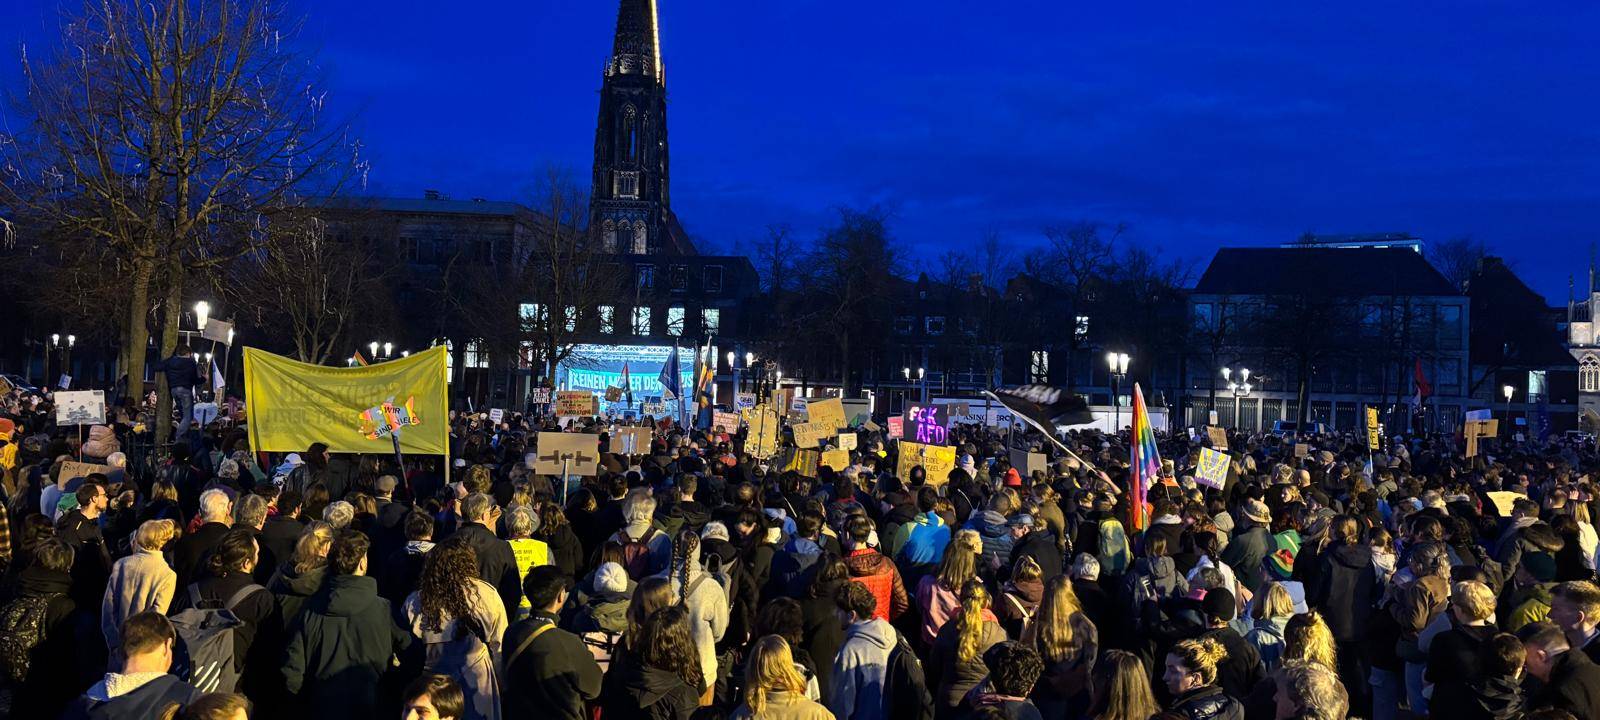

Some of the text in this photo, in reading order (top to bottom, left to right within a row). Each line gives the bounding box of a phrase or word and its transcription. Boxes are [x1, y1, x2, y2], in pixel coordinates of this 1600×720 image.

[573, 372, 606, 390] KEINEN
[384, 406, 401, 414] WIR
[909, 406, 938, 425] FCK
[374, 416, 417, 438] SIND VIELE
[917, 423, 944, 444] AFD
